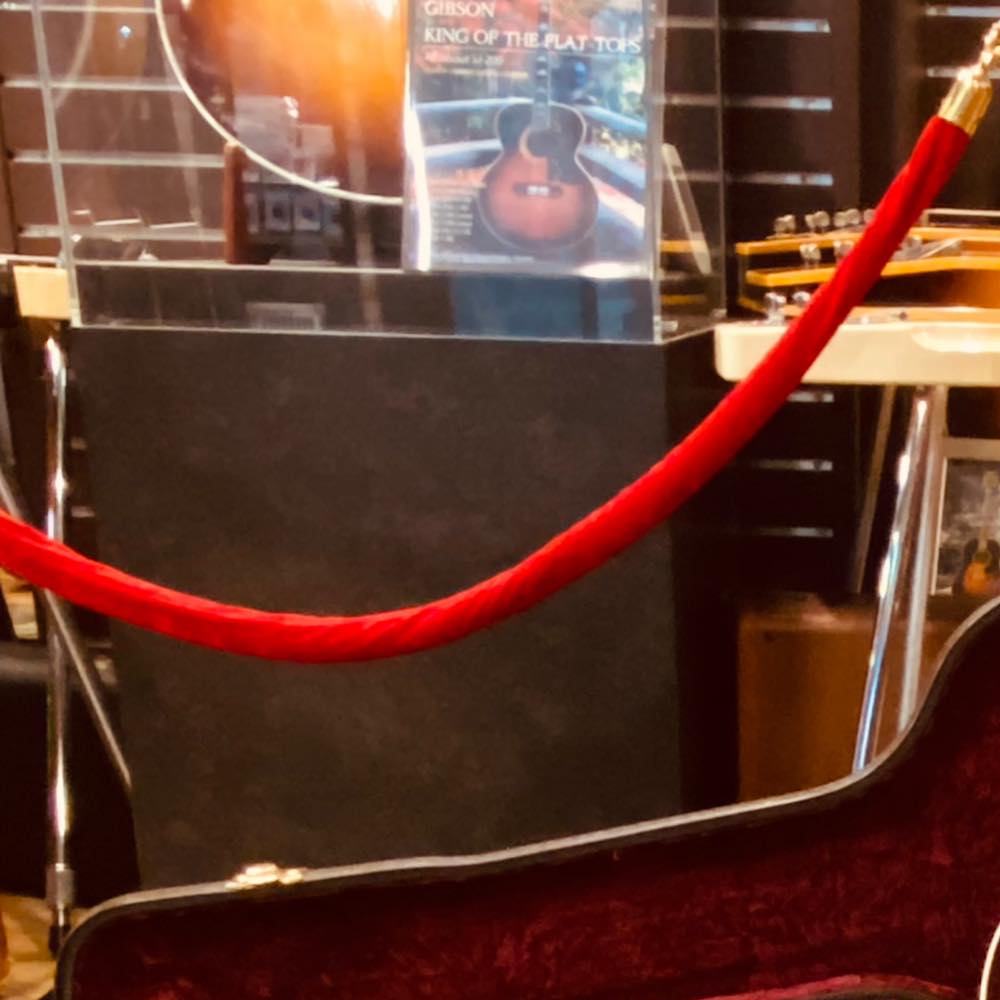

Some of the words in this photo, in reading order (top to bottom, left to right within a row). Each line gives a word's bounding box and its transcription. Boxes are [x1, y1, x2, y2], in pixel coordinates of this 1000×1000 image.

[424, 0, 494, 17] GIBSON
[424, 27, 468, 43] KING
[473, 30, 498, 46] OF
[503, 31, 539, 48] THE
[544, 34, 588, 51] FLAT
